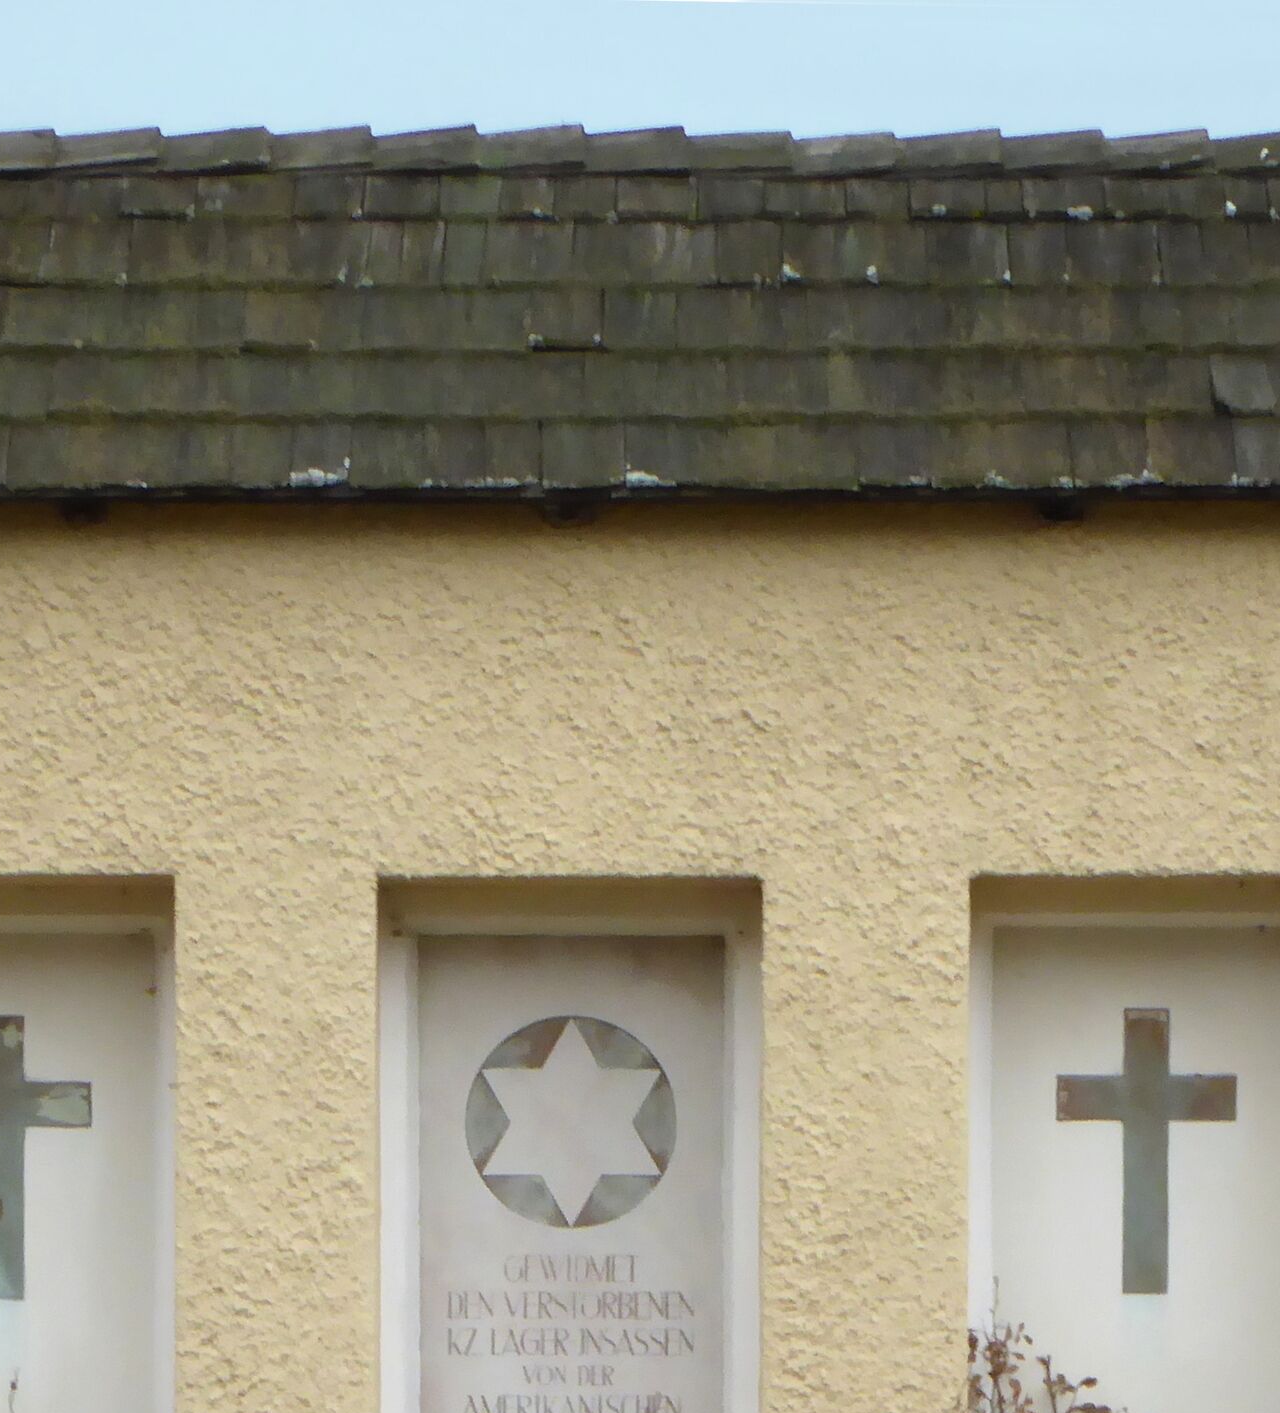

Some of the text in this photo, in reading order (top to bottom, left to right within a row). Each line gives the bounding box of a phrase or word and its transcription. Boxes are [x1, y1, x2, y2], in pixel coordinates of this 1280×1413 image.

[503, 1253, 639, 1284] GEWIDMET
[447, 1290, 696, 1320] DEN VERSTORBENEN
[447, 1327, 478, 1356] KZ
[491, 1327, 570, 1356] LAGER
[522, 1365, 615, 1386] VON DER
